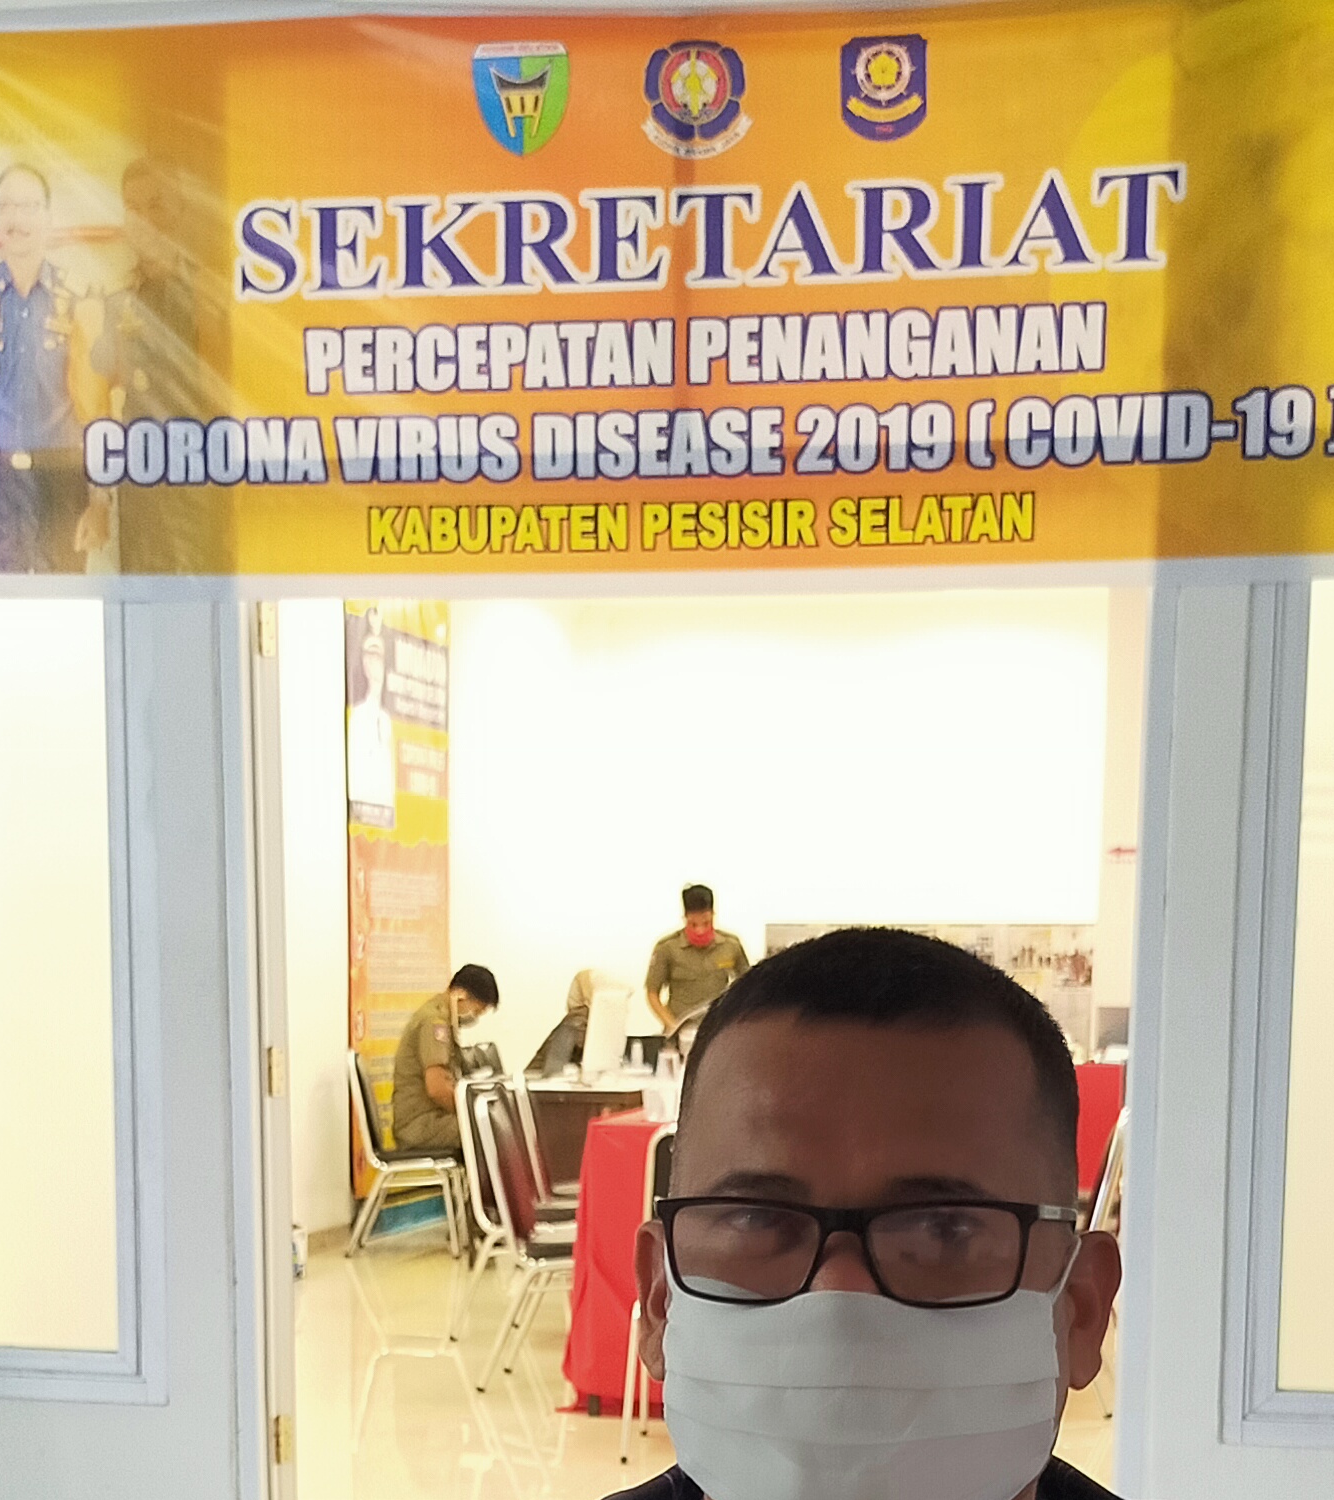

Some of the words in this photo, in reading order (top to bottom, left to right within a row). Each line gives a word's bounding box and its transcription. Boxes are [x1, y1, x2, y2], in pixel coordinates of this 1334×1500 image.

[238, 166, 1185, 299] SEKRETARIAT
[304, 318, 674, 395] PERCEPATAN
[688, 301, 1106, 385] PENANGANAN
[84, 416, 328, 488] CORONA
[334, 412, 519, 485] VIRUS
[532, 403, 784, 481] DISEASE
[795, 399, 955, 475] 2019
[1006, 386, 1314, 468] COVID-19
[368, 503, 628, 555] KABUPATEN
[641, 498, 817, 551] PESISIR
[828, 491, 1035, 547] SELATAN
